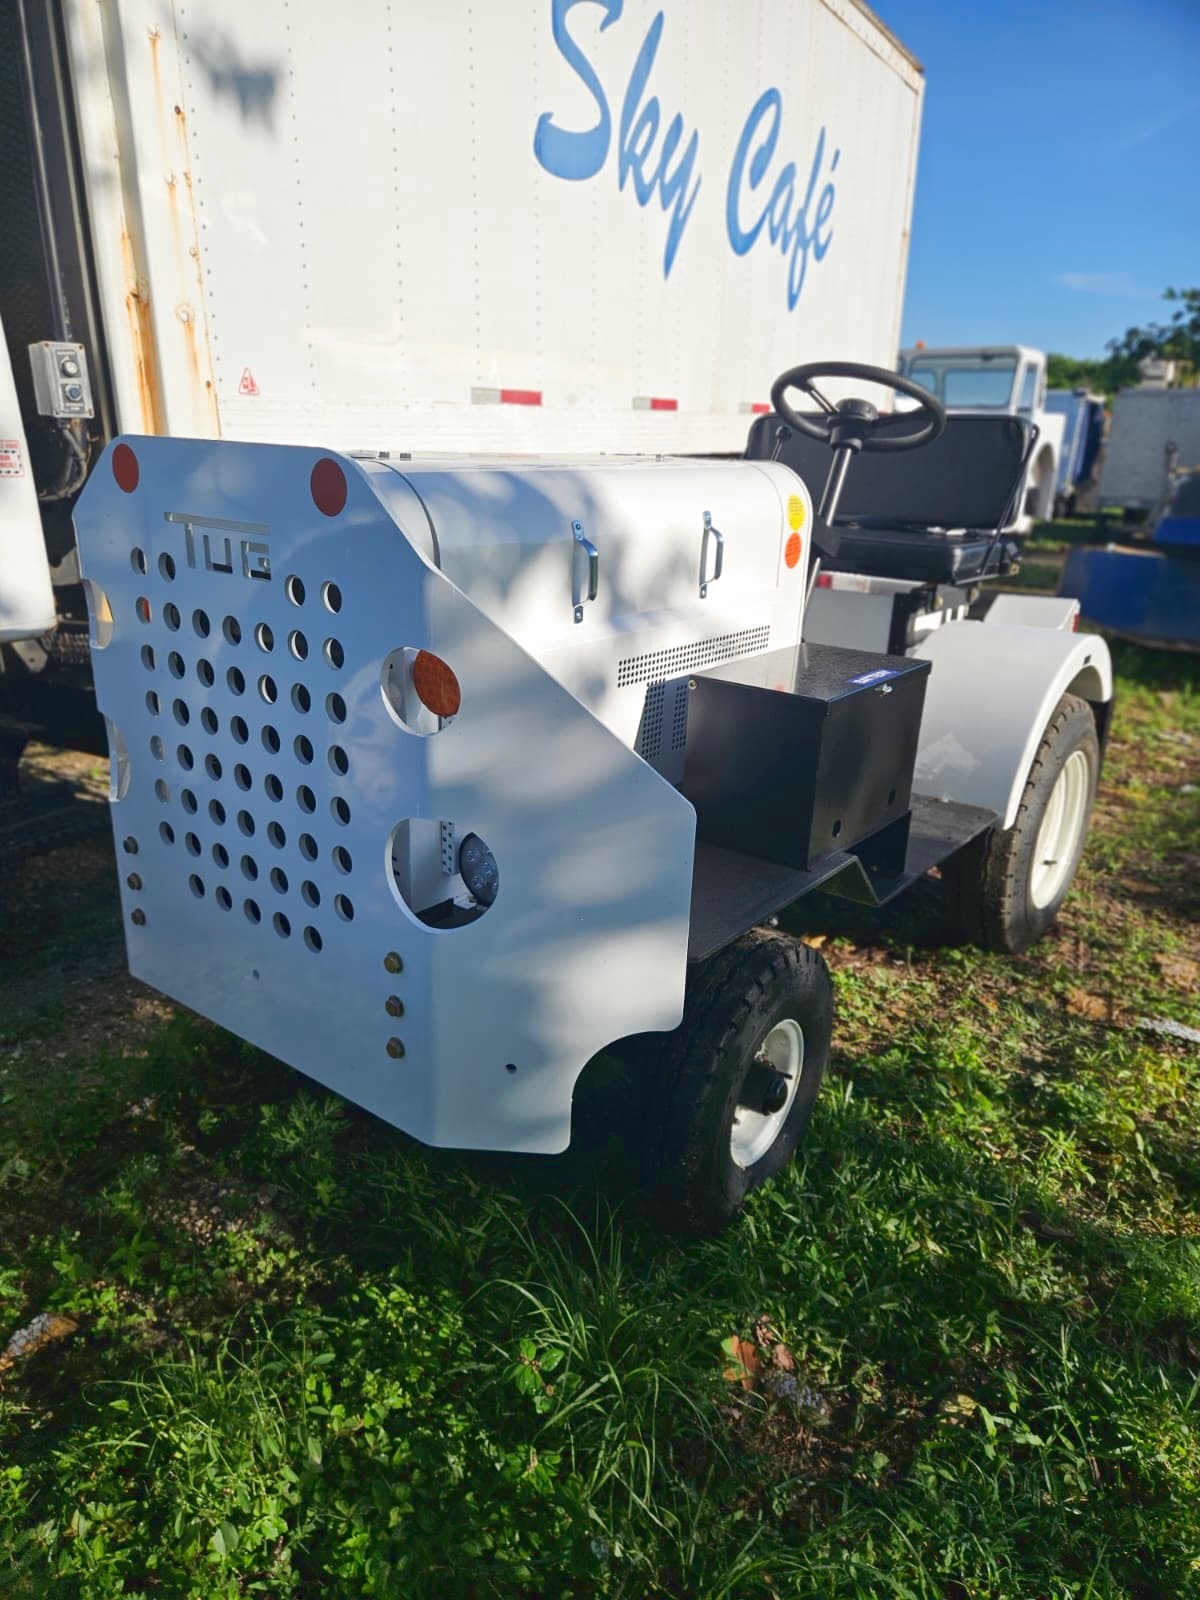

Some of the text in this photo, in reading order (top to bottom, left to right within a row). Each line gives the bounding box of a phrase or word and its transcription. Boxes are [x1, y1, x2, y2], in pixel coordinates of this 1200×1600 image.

[533, 0, 840, 312] Sky Café
[163, 511, 272, 581] TUG
